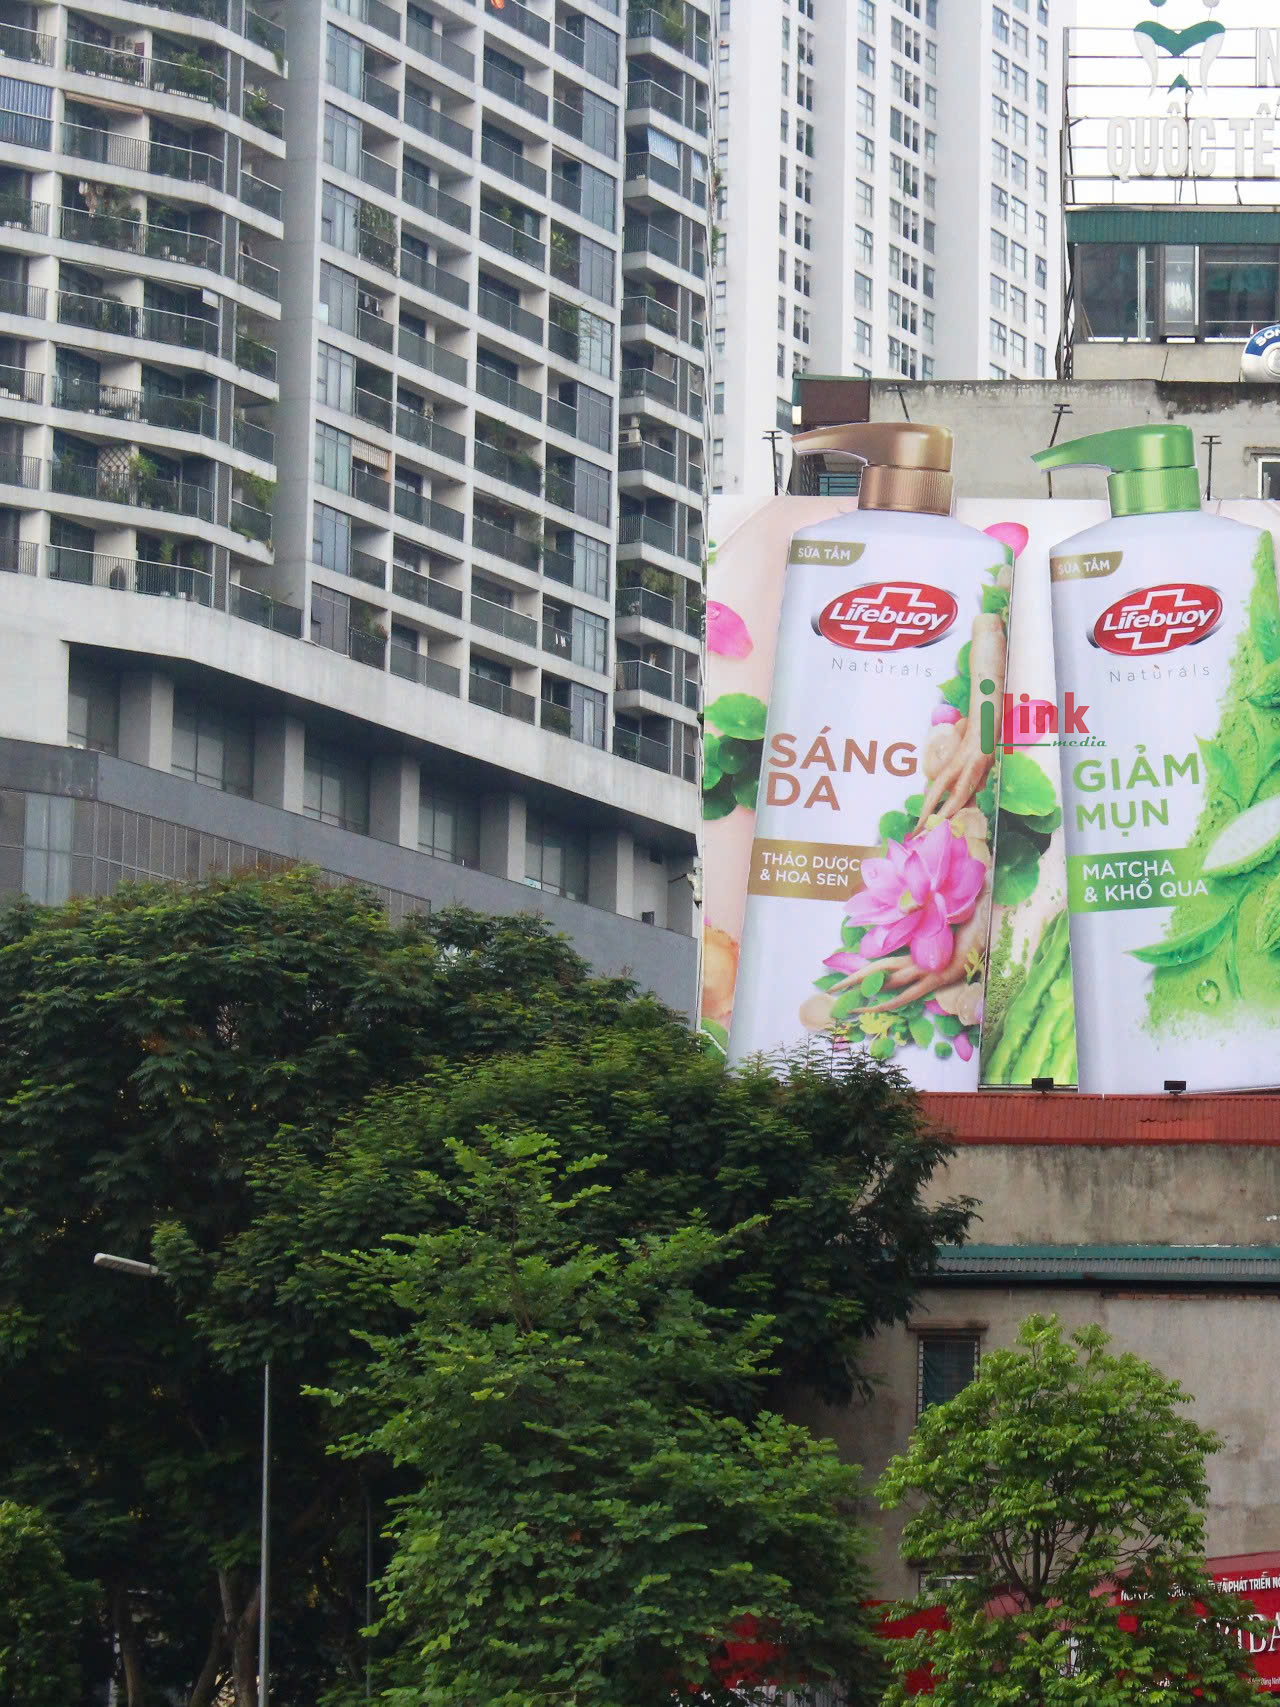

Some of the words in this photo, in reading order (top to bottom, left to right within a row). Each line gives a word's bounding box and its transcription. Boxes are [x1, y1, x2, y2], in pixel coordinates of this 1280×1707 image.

[798, 545, 820, 559] SỮA
[829, 602, 949, 631] Lifebuoy
[1103, 608, 1215, 631] Lifebuoy
[766, 725, 918, 778] SÁNG
[1072, 744, 1200, 793] GIẢM
[766, 771, 841, 812] DA
[1075, 798, 1169, 838] MỤN
[762, 849, 808, 868] THẢO
[812, 855, 860, 876] DƯỢC
[1082, 859, 1176, 881] MATCHA
[759, 868, 771, 882] &
[775, 869, 813, 885] HOA
[816, 872, 849, 887] SEN
[1083, 886, 1098, 903] &
[1105, 877, 1153, 902] KHỔ
[1160, 879, 1209, 898] QUA
[1228, 1576, 1248, 1592] PHÁT
